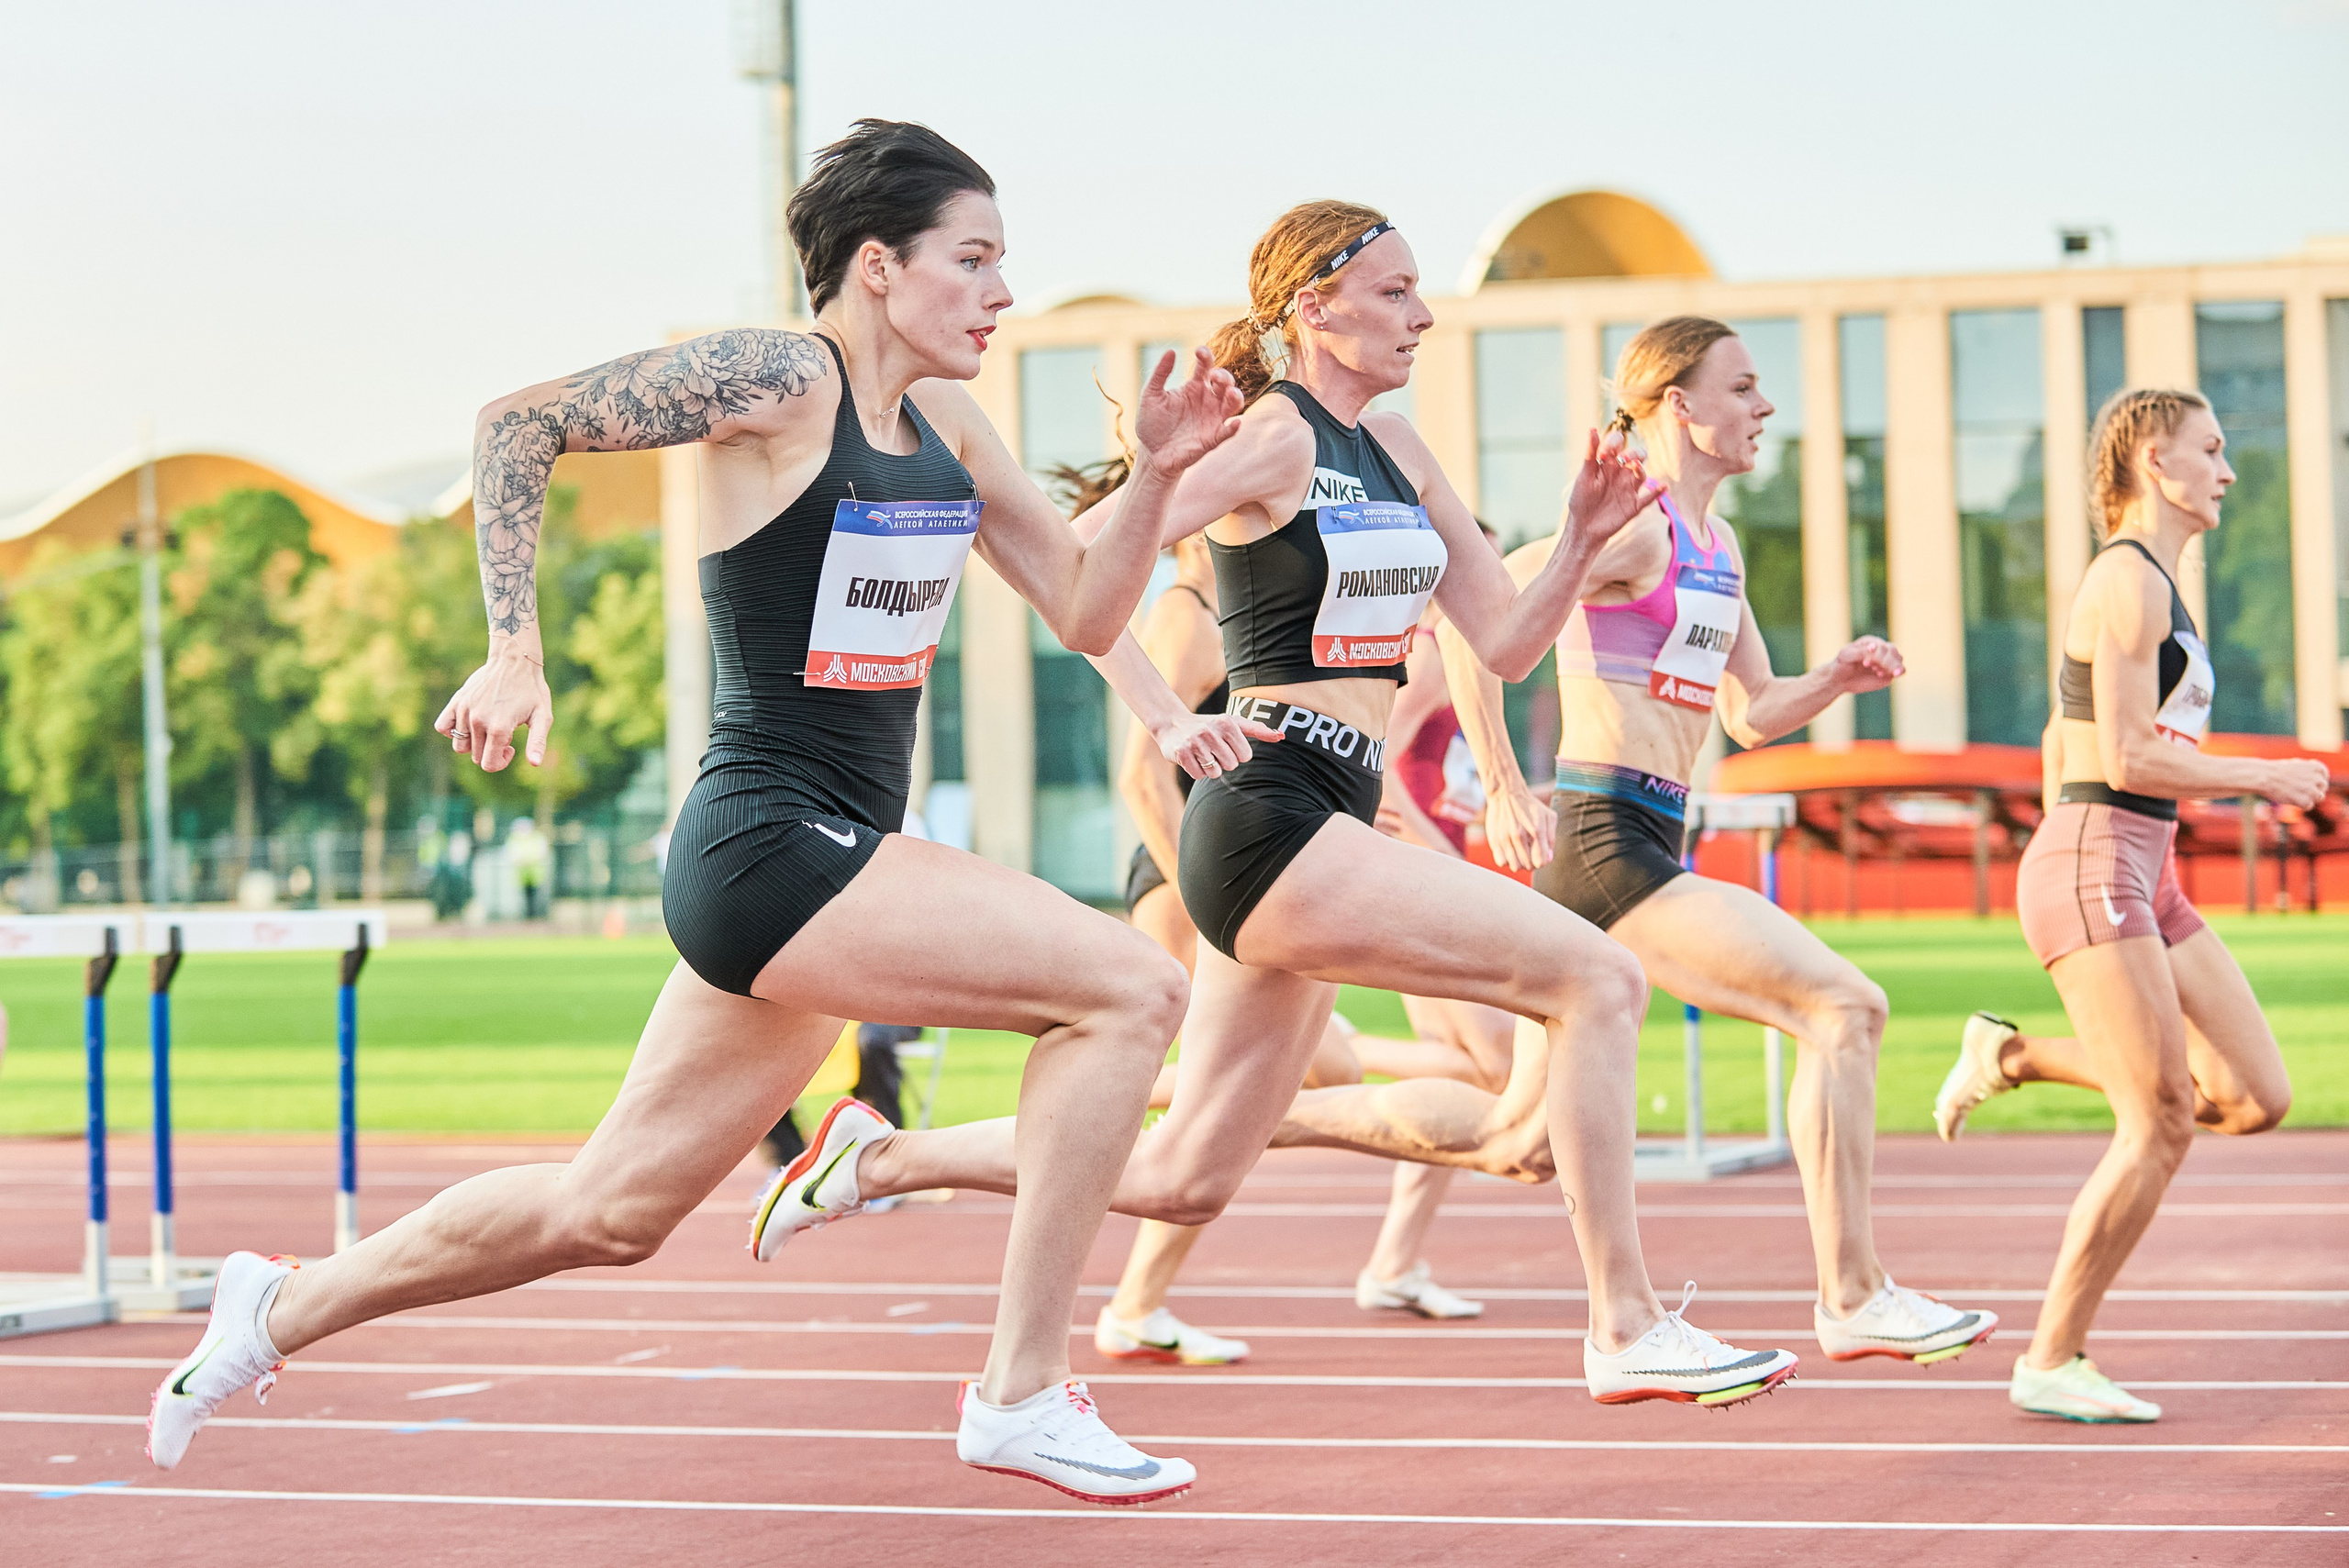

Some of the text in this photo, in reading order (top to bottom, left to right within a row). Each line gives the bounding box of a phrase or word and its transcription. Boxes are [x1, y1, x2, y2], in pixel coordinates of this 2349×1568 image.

[1330, 250, 1349, 271] NIKE
[1361, 227, 1379, 245] NIKE
[1310, 477, 1364, 504] NIKE
[894, 519, 968, 528] ЛЕГКОЙ АТЛЕТИКИ
[895, 509, 939, 519] ВСЕРОССИЙСКАЯ
[1336, 565, 1439, 598] РОМАНОВСКАЯ
[845, 577, 950, 617] БОЛДЫРЕВА
[850, 657, 918, 683] МОСКОВСКИЙ
[1277, 705, 1360, 758] PRO
[1644, 776, 1687, 805] NIKE
